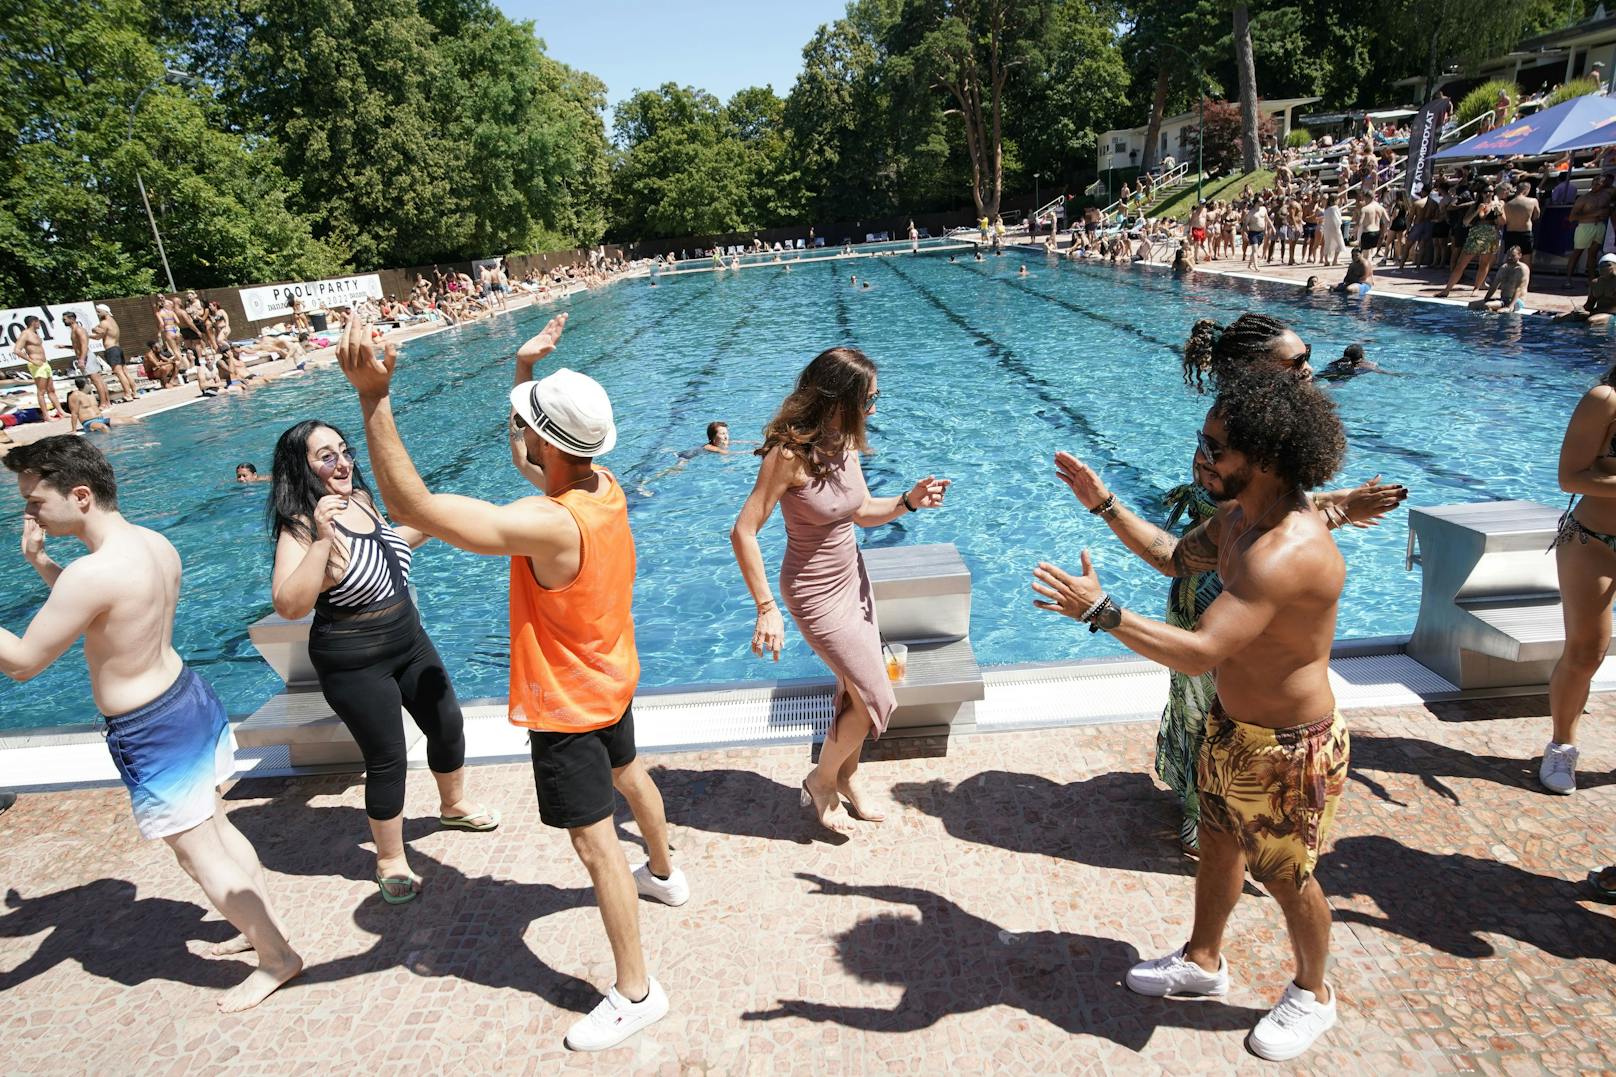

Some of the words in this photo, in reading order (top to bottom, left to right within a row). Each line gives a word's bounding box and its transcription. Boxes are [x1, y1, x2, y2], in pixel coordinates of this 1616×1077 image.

[1415, 110, 1434, 181] ATOMBODY.AT
[273, 285, 312, 301] POOL
[319, 279, 358, 295] PARTY
[328, 294, 348, 305] 2022
